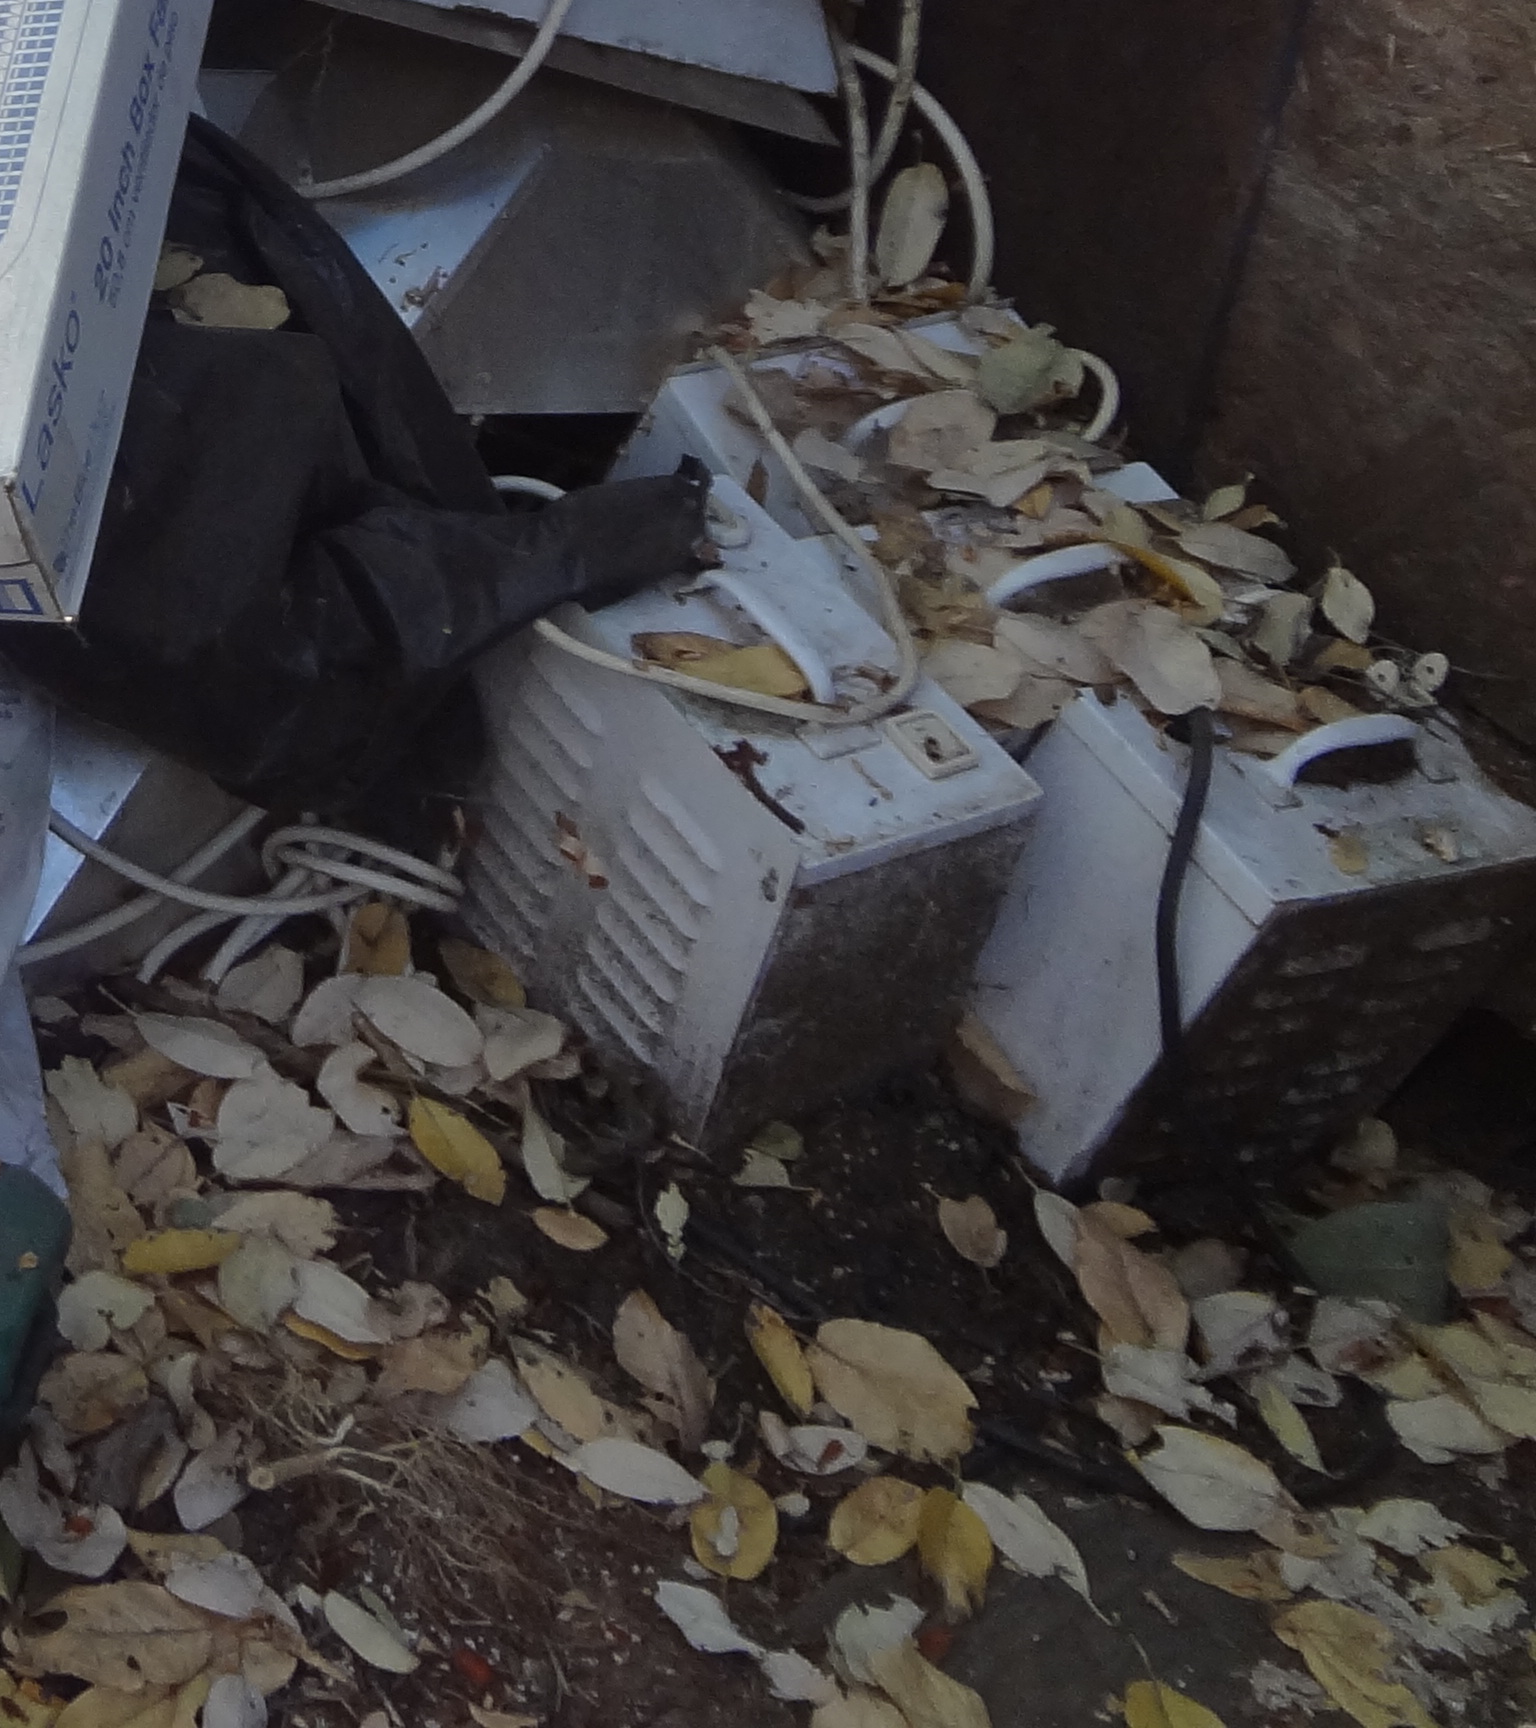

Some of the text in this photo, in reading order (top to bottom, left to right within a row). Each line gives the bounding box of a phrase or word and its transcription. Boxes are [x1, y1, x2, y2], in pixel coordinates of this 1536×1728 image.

[93, 236, 115, 305] 20
[108, 140, 136, 233] Inch
[130, 48, 156, 135] Box
[21, 308, 81, 516] Lasko
